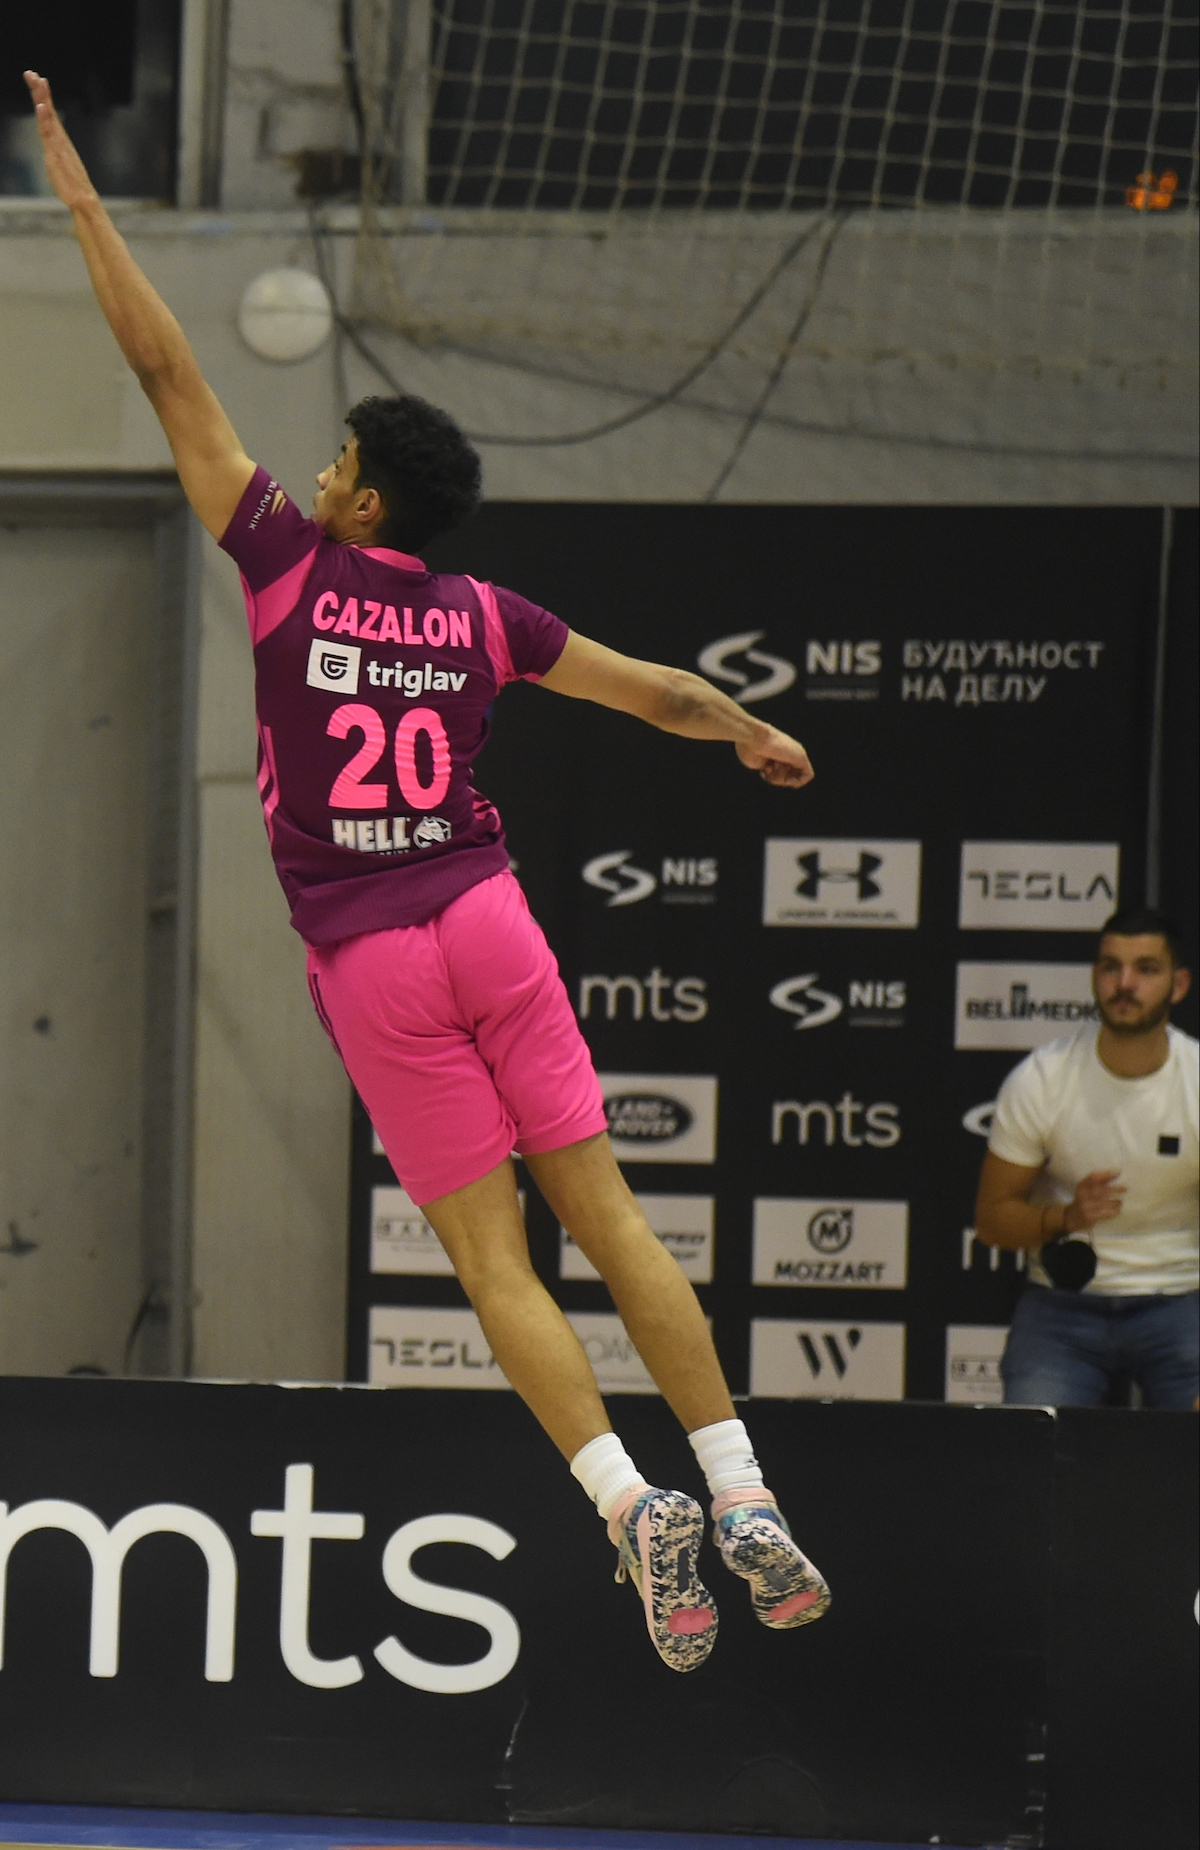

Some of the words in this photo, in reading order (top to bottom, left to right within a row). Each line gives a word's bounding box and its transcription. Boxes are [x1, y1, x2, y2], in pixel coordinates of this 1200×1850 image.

[248, 494, 272, 530] PUTNIK
[312, 590, 473, 649] CAZALON
[806, 640, 882, 676] NIS
[367, 661, 468, 698] triglav
[902, 675, 946, 701] НА
[954, 674, 1048, 707] ДЕЛУ
[326, 703, 453, 810] 20
[331, 817, 411, 853] HELL
[662, 857, 718, 886] NIS
[968, 871, 1113, 901] TESLA
[579, 966, 709, 1022] mts
[849, 979, 907, 1009] NIS
[771, 1091, 901, 1148] mts
[774, 1260, 885, 1282] MOZZART
[374, 1337, 498, 1369] TESL
